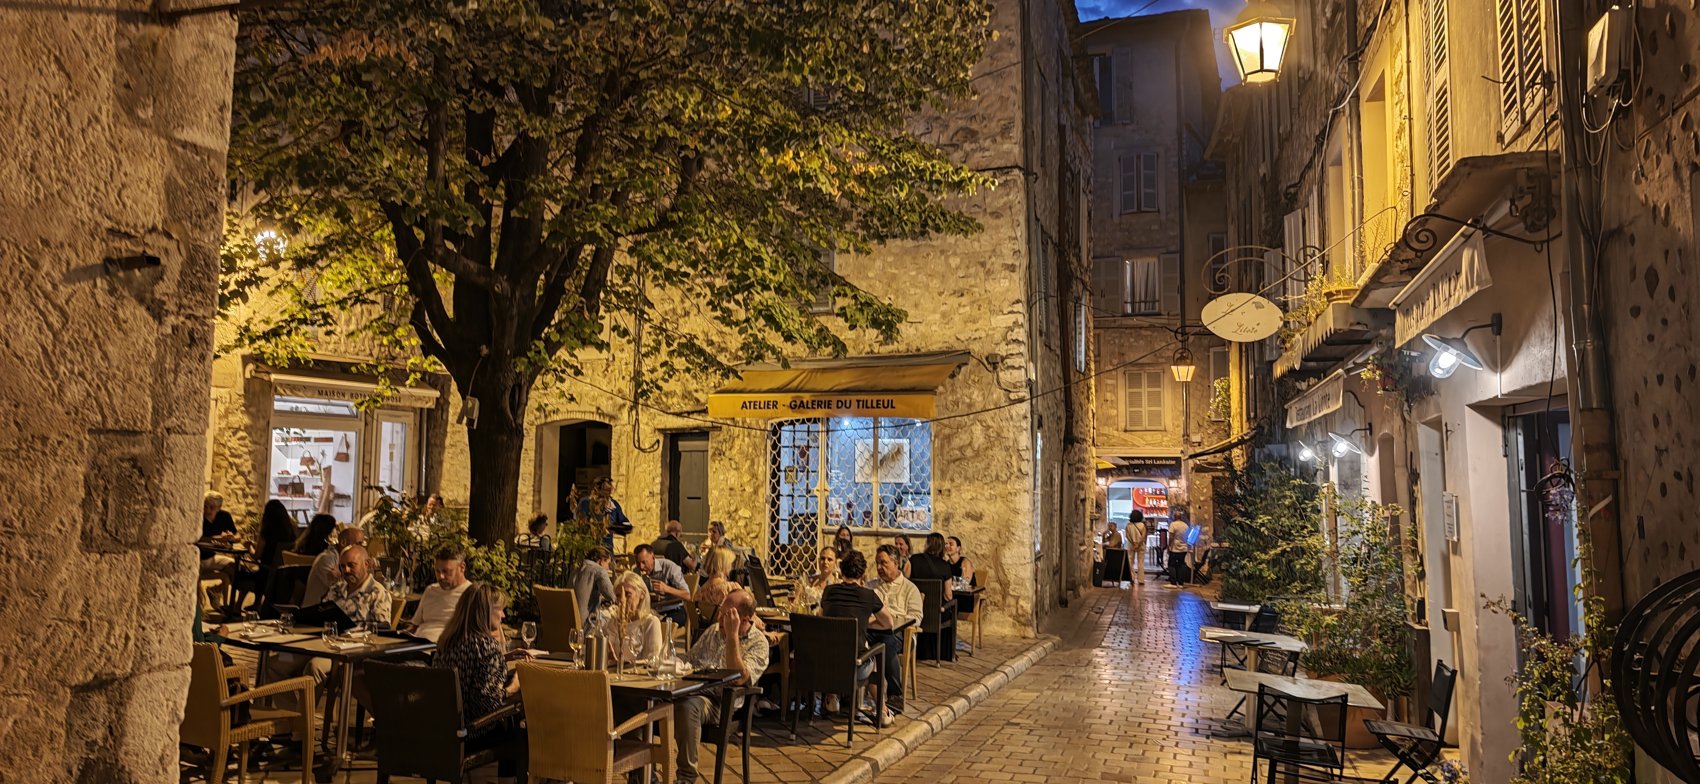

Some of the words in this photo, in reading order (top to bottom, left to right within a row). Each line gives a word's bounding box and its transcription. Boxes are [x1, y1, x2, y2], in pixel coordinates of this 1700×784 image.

[317, 389, 346, 400] MAISON
[741, 400, 779, 410] ATELIER
[789, 400, 832, 410] GALERIE
[836, 400, 852, 409] DU
[855, 399, 896, 409] TILLEUL
